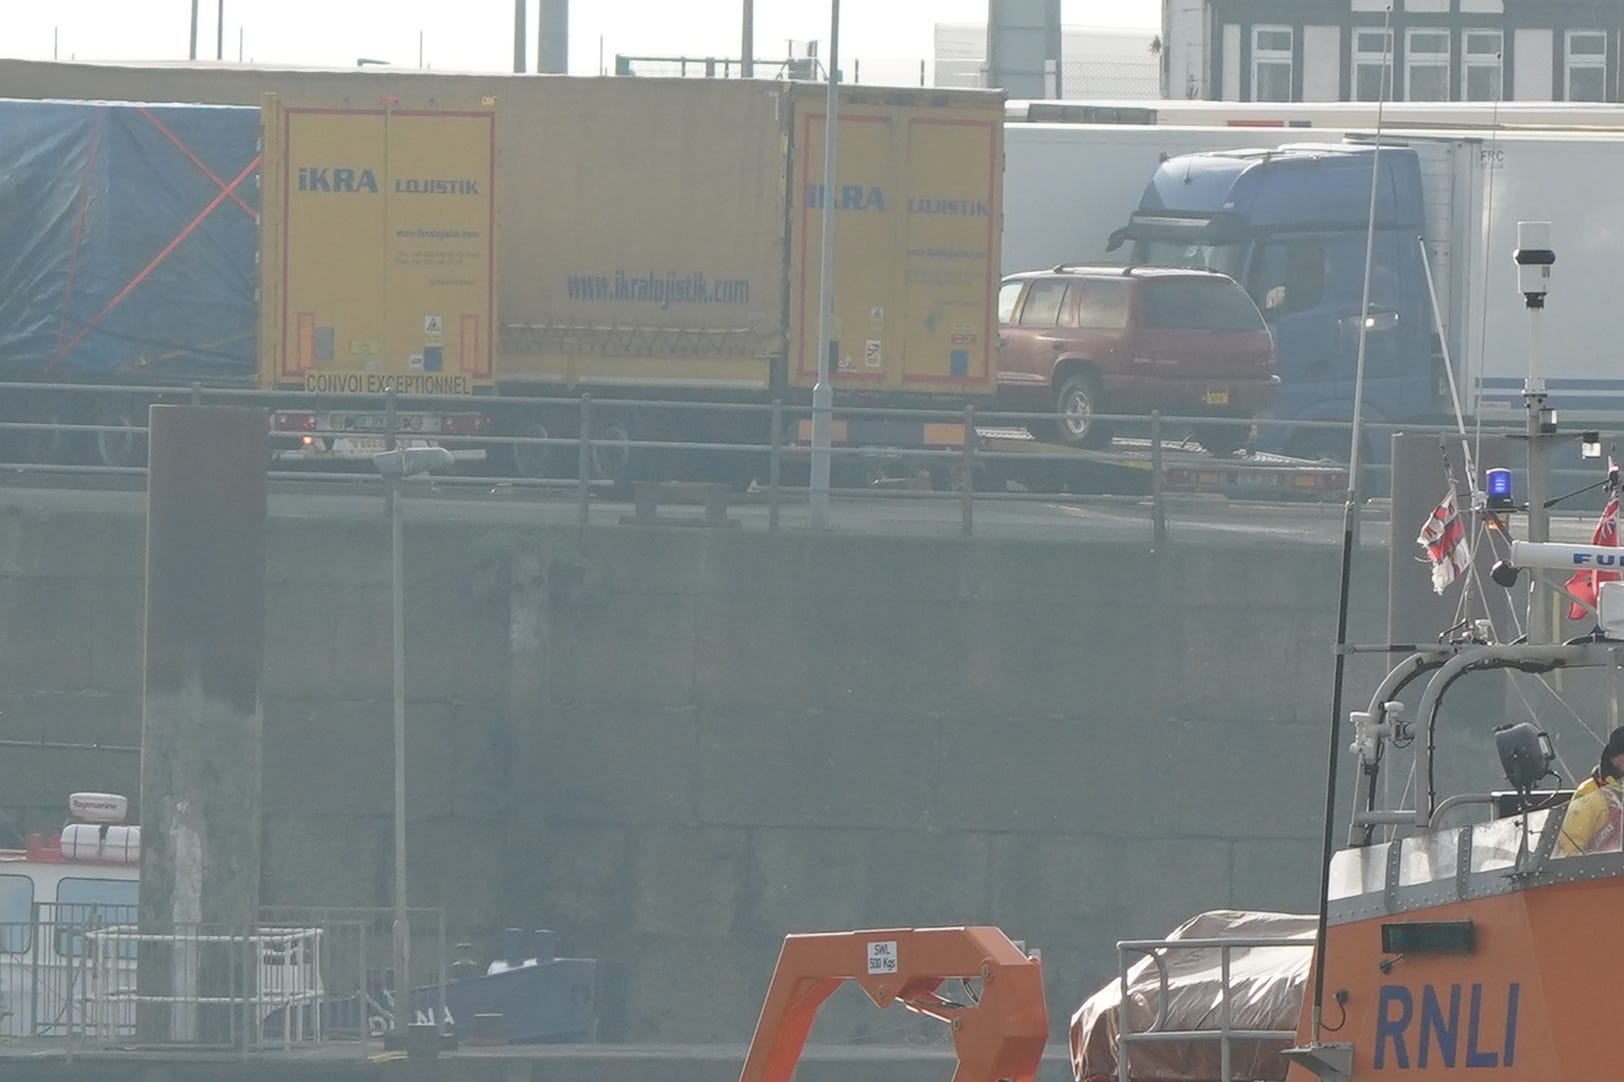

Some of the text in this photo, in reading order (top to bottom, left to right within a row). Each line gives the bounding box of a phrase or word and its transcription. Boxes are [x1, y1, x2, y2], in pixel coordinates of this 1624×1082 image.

[1480, 150, 1505, 162] FRC
[567, 269, 750, 311] www.ikralojistik.com
[306, 375, 470, 396] CONVOI EXCEPTIONNEL
[1373, 982, 1520, 1070] RNLI
